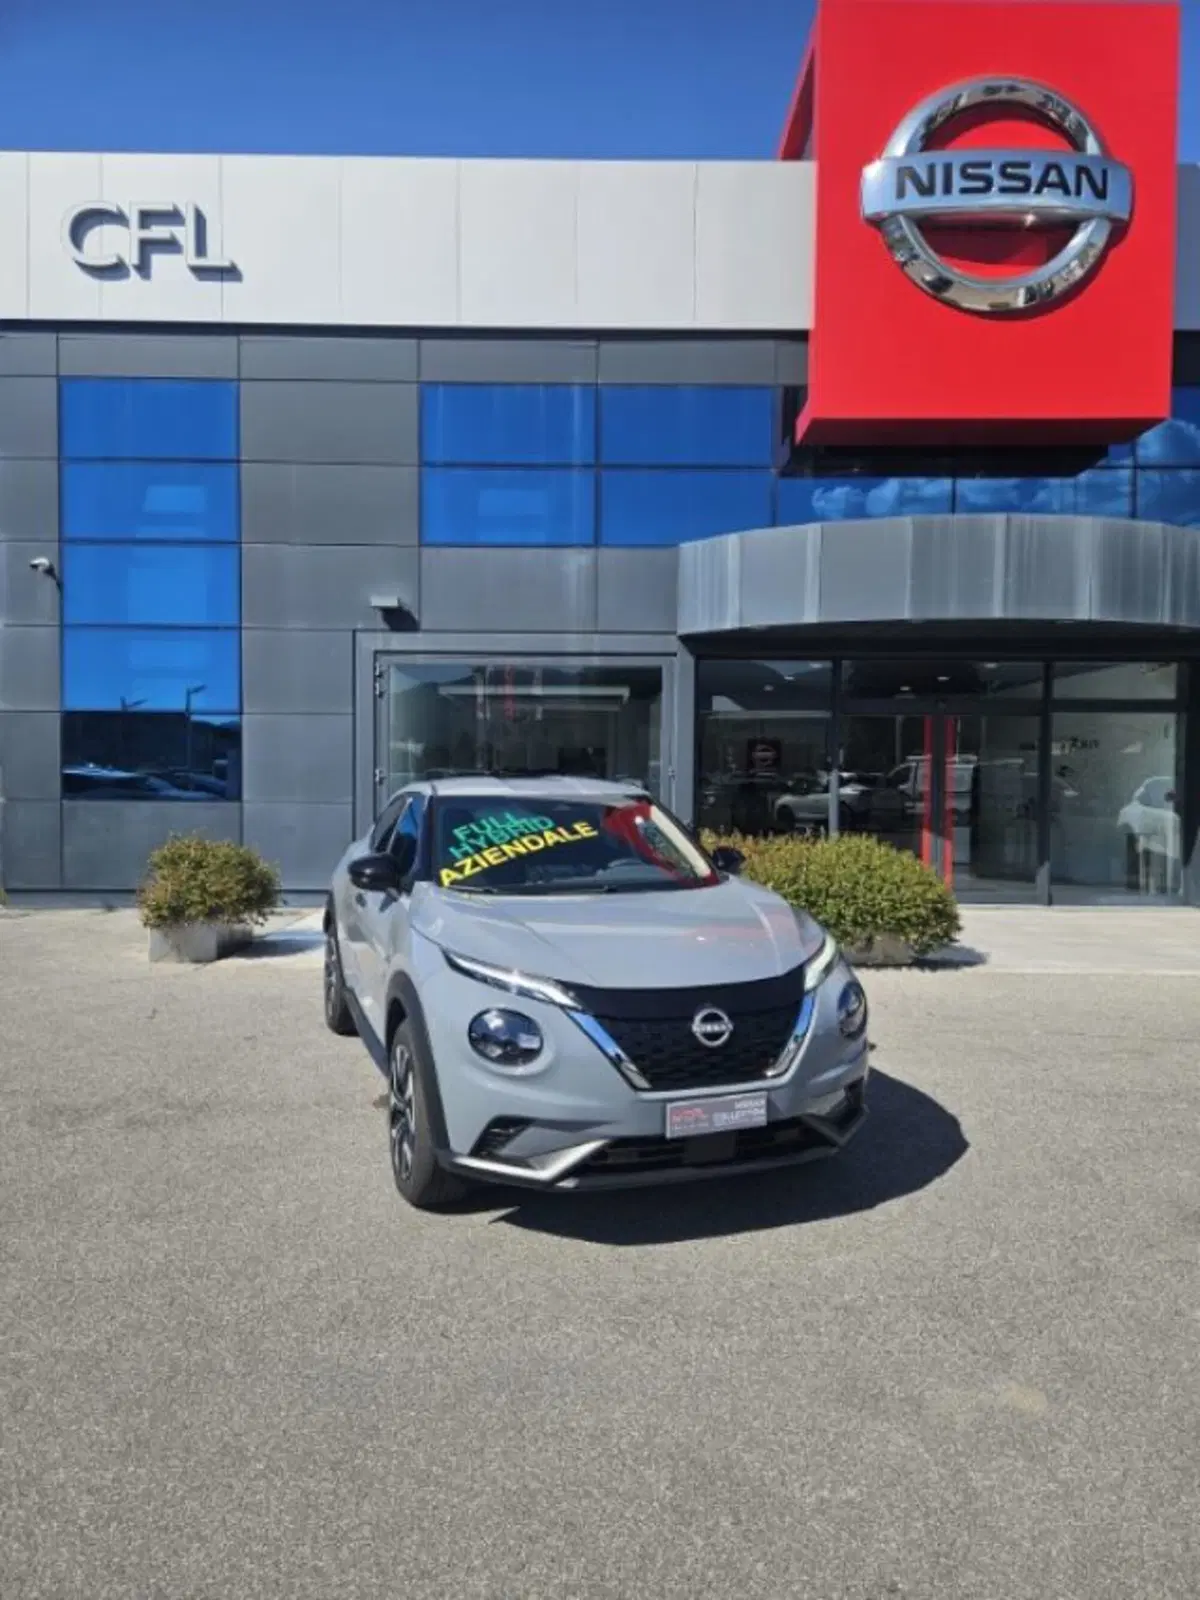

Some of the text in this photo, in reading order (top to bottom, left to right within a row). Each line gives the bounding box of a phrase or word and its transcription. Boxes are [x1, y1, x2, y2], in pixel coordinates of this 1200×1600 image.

[896, 160, 1109, 201] NISSAN
[61, 200, 243, 282] CFL
[452, 811, 524, 842] FULL
[439, 821, 599, 887] AZIENDALE
